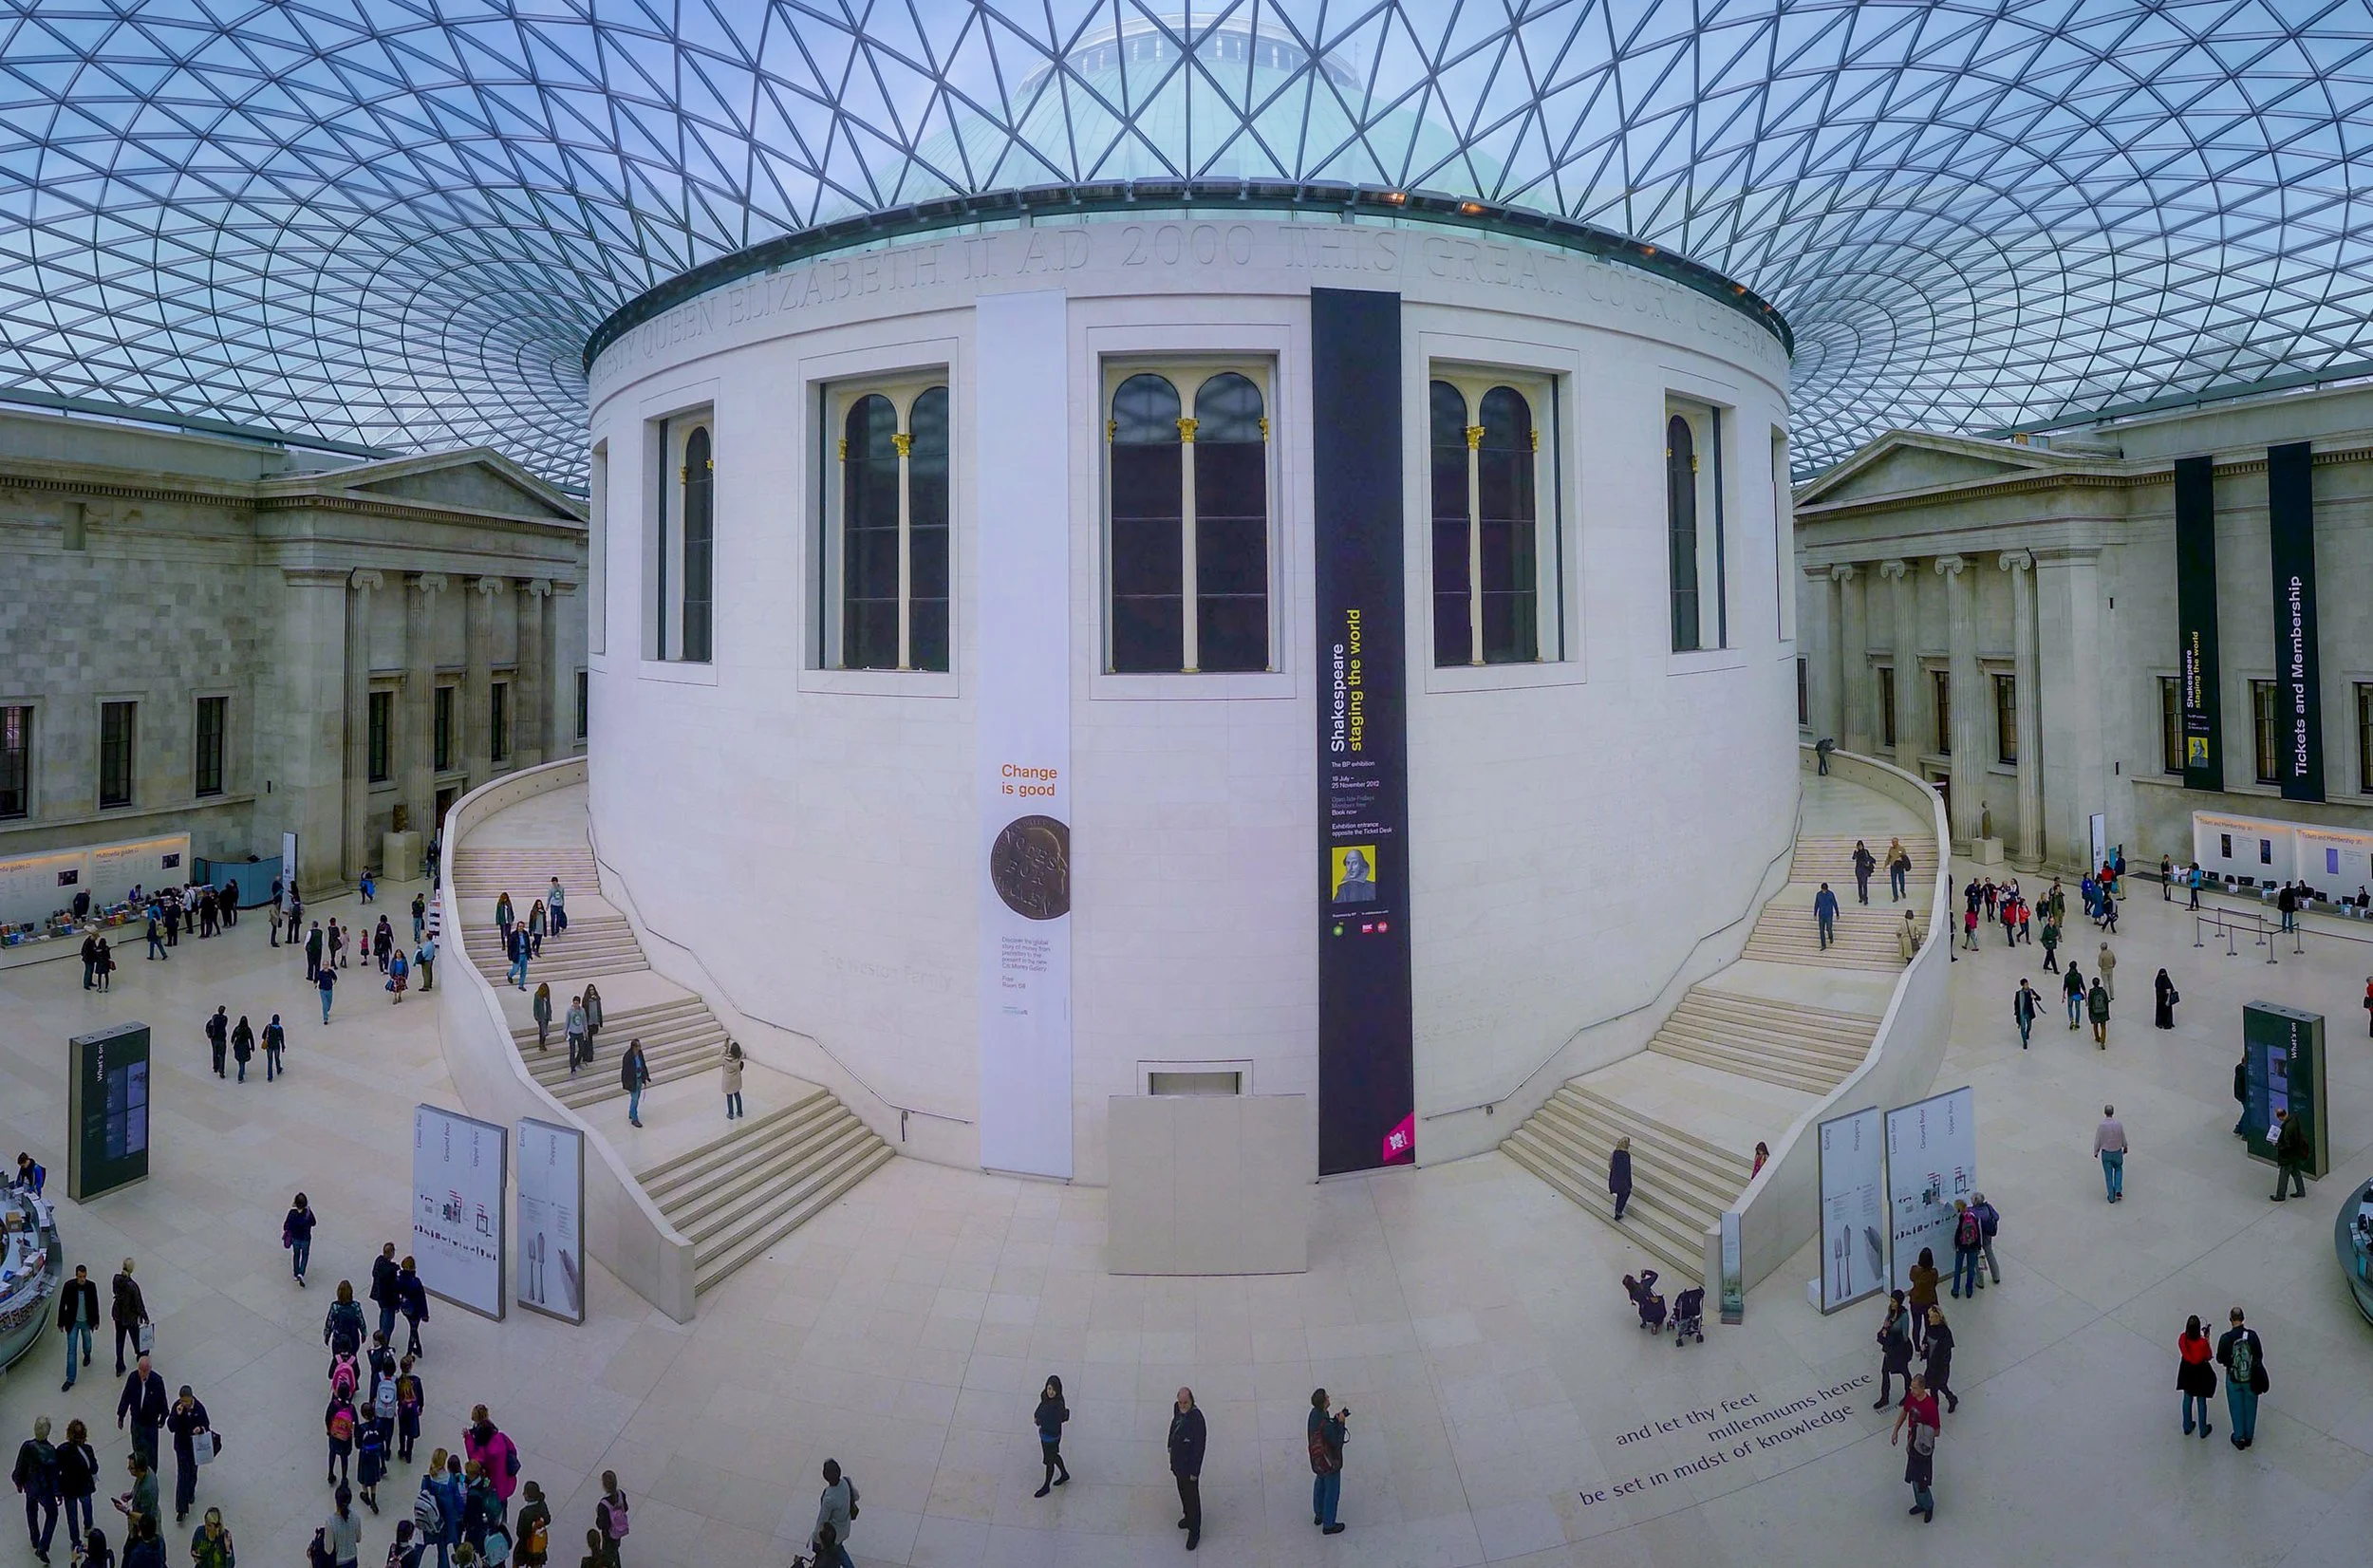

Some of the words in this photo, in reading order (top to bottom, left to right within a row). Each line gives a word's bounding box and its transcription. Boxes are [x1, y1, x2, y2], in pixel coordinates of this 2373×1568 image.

[643, 296, 718, 359] QUEEN
[727, 243, 944, 327] ELIZABETH
[963, 237, 998, 280] II
[1017, 230, 1092, 275] AD
[1121, 224, 1253, 268] 2000
[1279, 226, 1398, 273] THIS
[1424, 236, 1567, 297] GREAT
[1585, 262, 1683, 325] COURT
[1347, 609, 1361, 654] world
[2289, 576, 2303, 678] Membership
[1348, 660, 1361, 686] the
[1331, 644, 1347, 753] Shakespeare
[2292, 683, 2305, 714] and
[1348, 691, 1364, 752] staging
[2295, 719, 2307, 776] Tickets
[1002, 764, 1057, 781] Change
[1002, 781, 1014, 794] is
[1018, 783, 1055, 797] good
[1332, 830, 1354, 838] opposite
[2326, 834, 2354, 846] Membership
[98, 1044, 103, 1054] on
[2291, 1022, 2297, 1032] on
[1616, 1425, 1651, 1446] and
[1655, 1417, 1681, 1434] let
[1686, 1408, 1715, 1425] thy
[1720, 1391, 1760, 1413] feet
[1709, 1396, 1817, 1442] millenniums
[1818, 1373, 1873, 1401] hence
[1579, 1490, 1607, 1506] be
[1613, 1478, 1644, 1497] set
[1650, 1471, 1670, 1486] in
[1673, 1451, 1728, 1480] midst
[1733, 1441, 1753, 1459] of
[1756, 1404, 1855, 1449] knowledge
